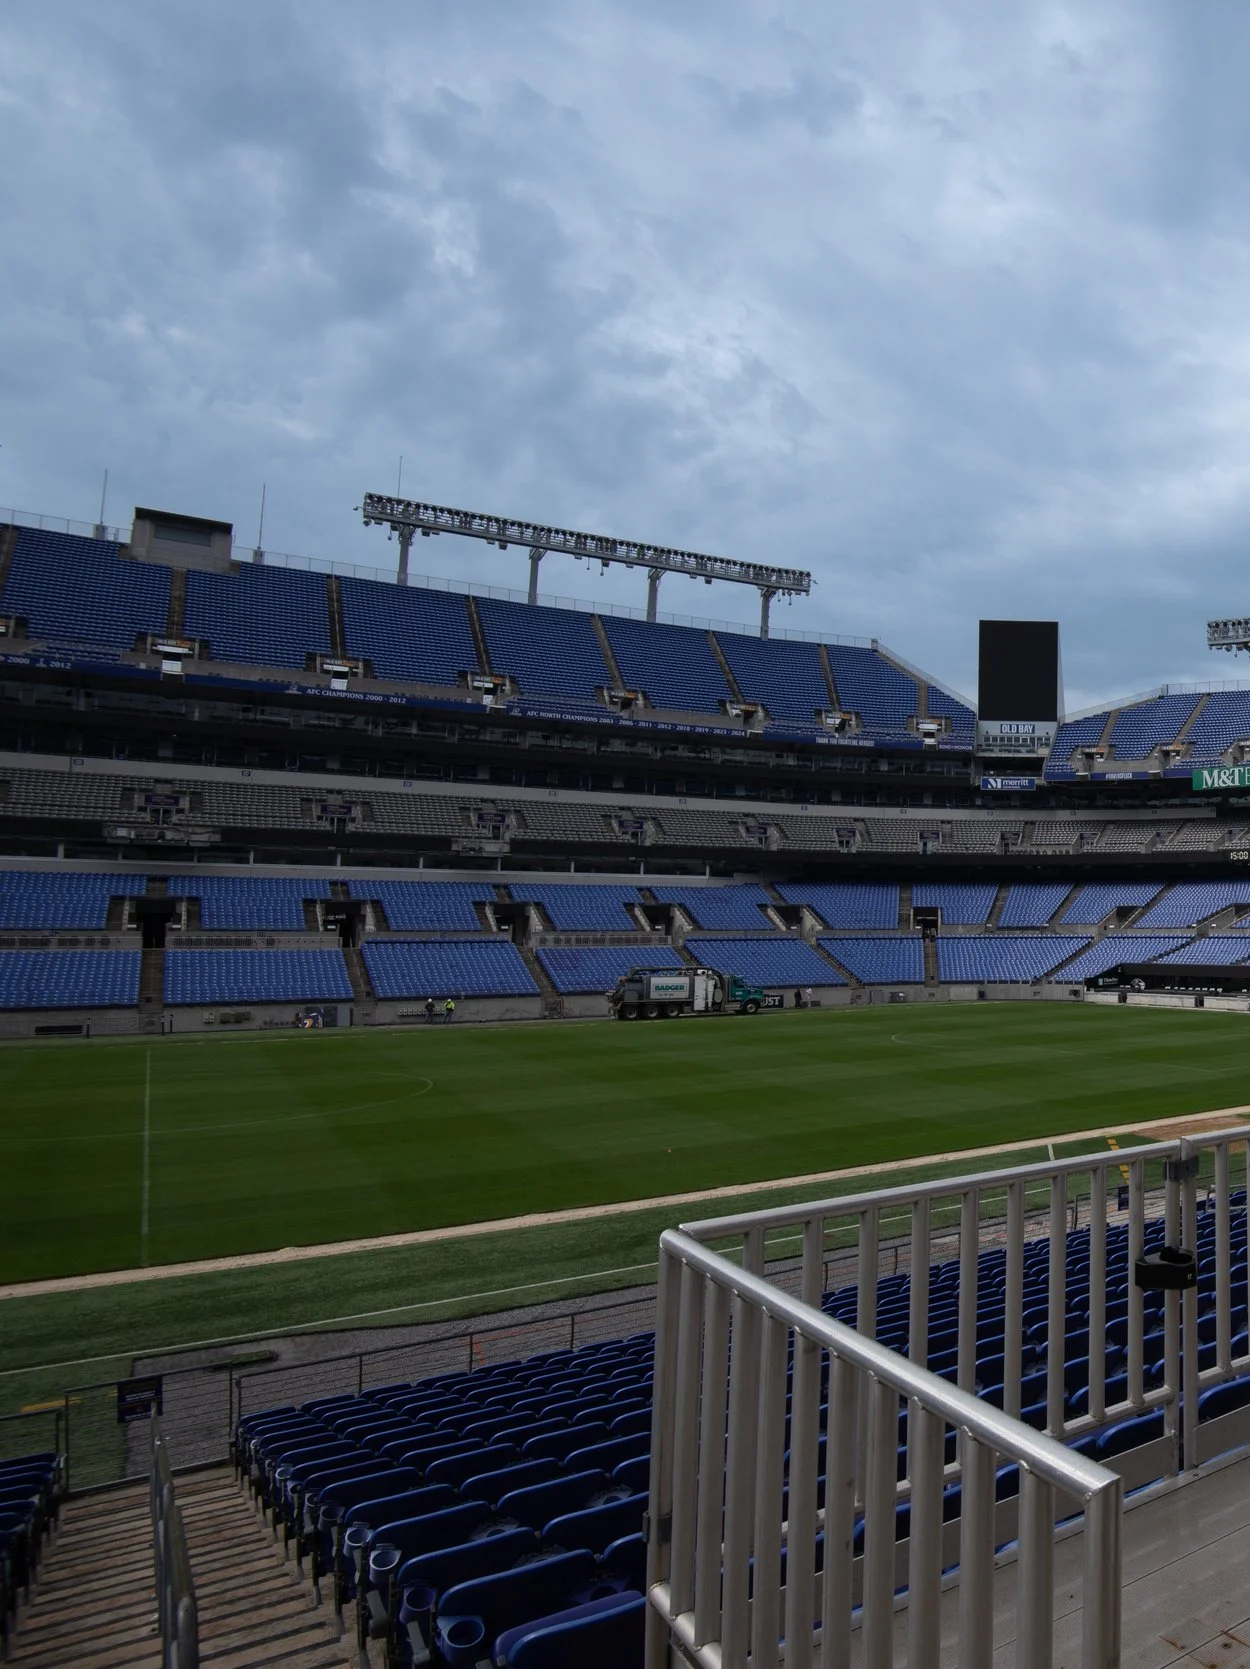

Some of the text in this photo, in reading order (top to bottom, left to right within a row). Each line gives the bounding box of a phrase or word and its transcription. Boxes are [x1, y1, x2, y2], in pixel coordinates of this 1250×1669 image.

[7, 656, 30, 665] 2000
[49, 661, 72, 670] 2012
[306, 688, 406, 704] AFC CHAMPIONS 2000 2012
[526, 710, 538, 718] AFC
[539, 711, 561, 720] NORTH
[561, 713, 598, 724] CHAMPIONS
[618, 719, 634, 727] 2006
[657, 722, 672, 730] 2012
[731, 729, 745, 738] 2024
[1002, 724, 1033, 734] OLD BAY
[1202, 767, 1244, 788] M&T
[1230, 851, 1249, 860] 15:00
